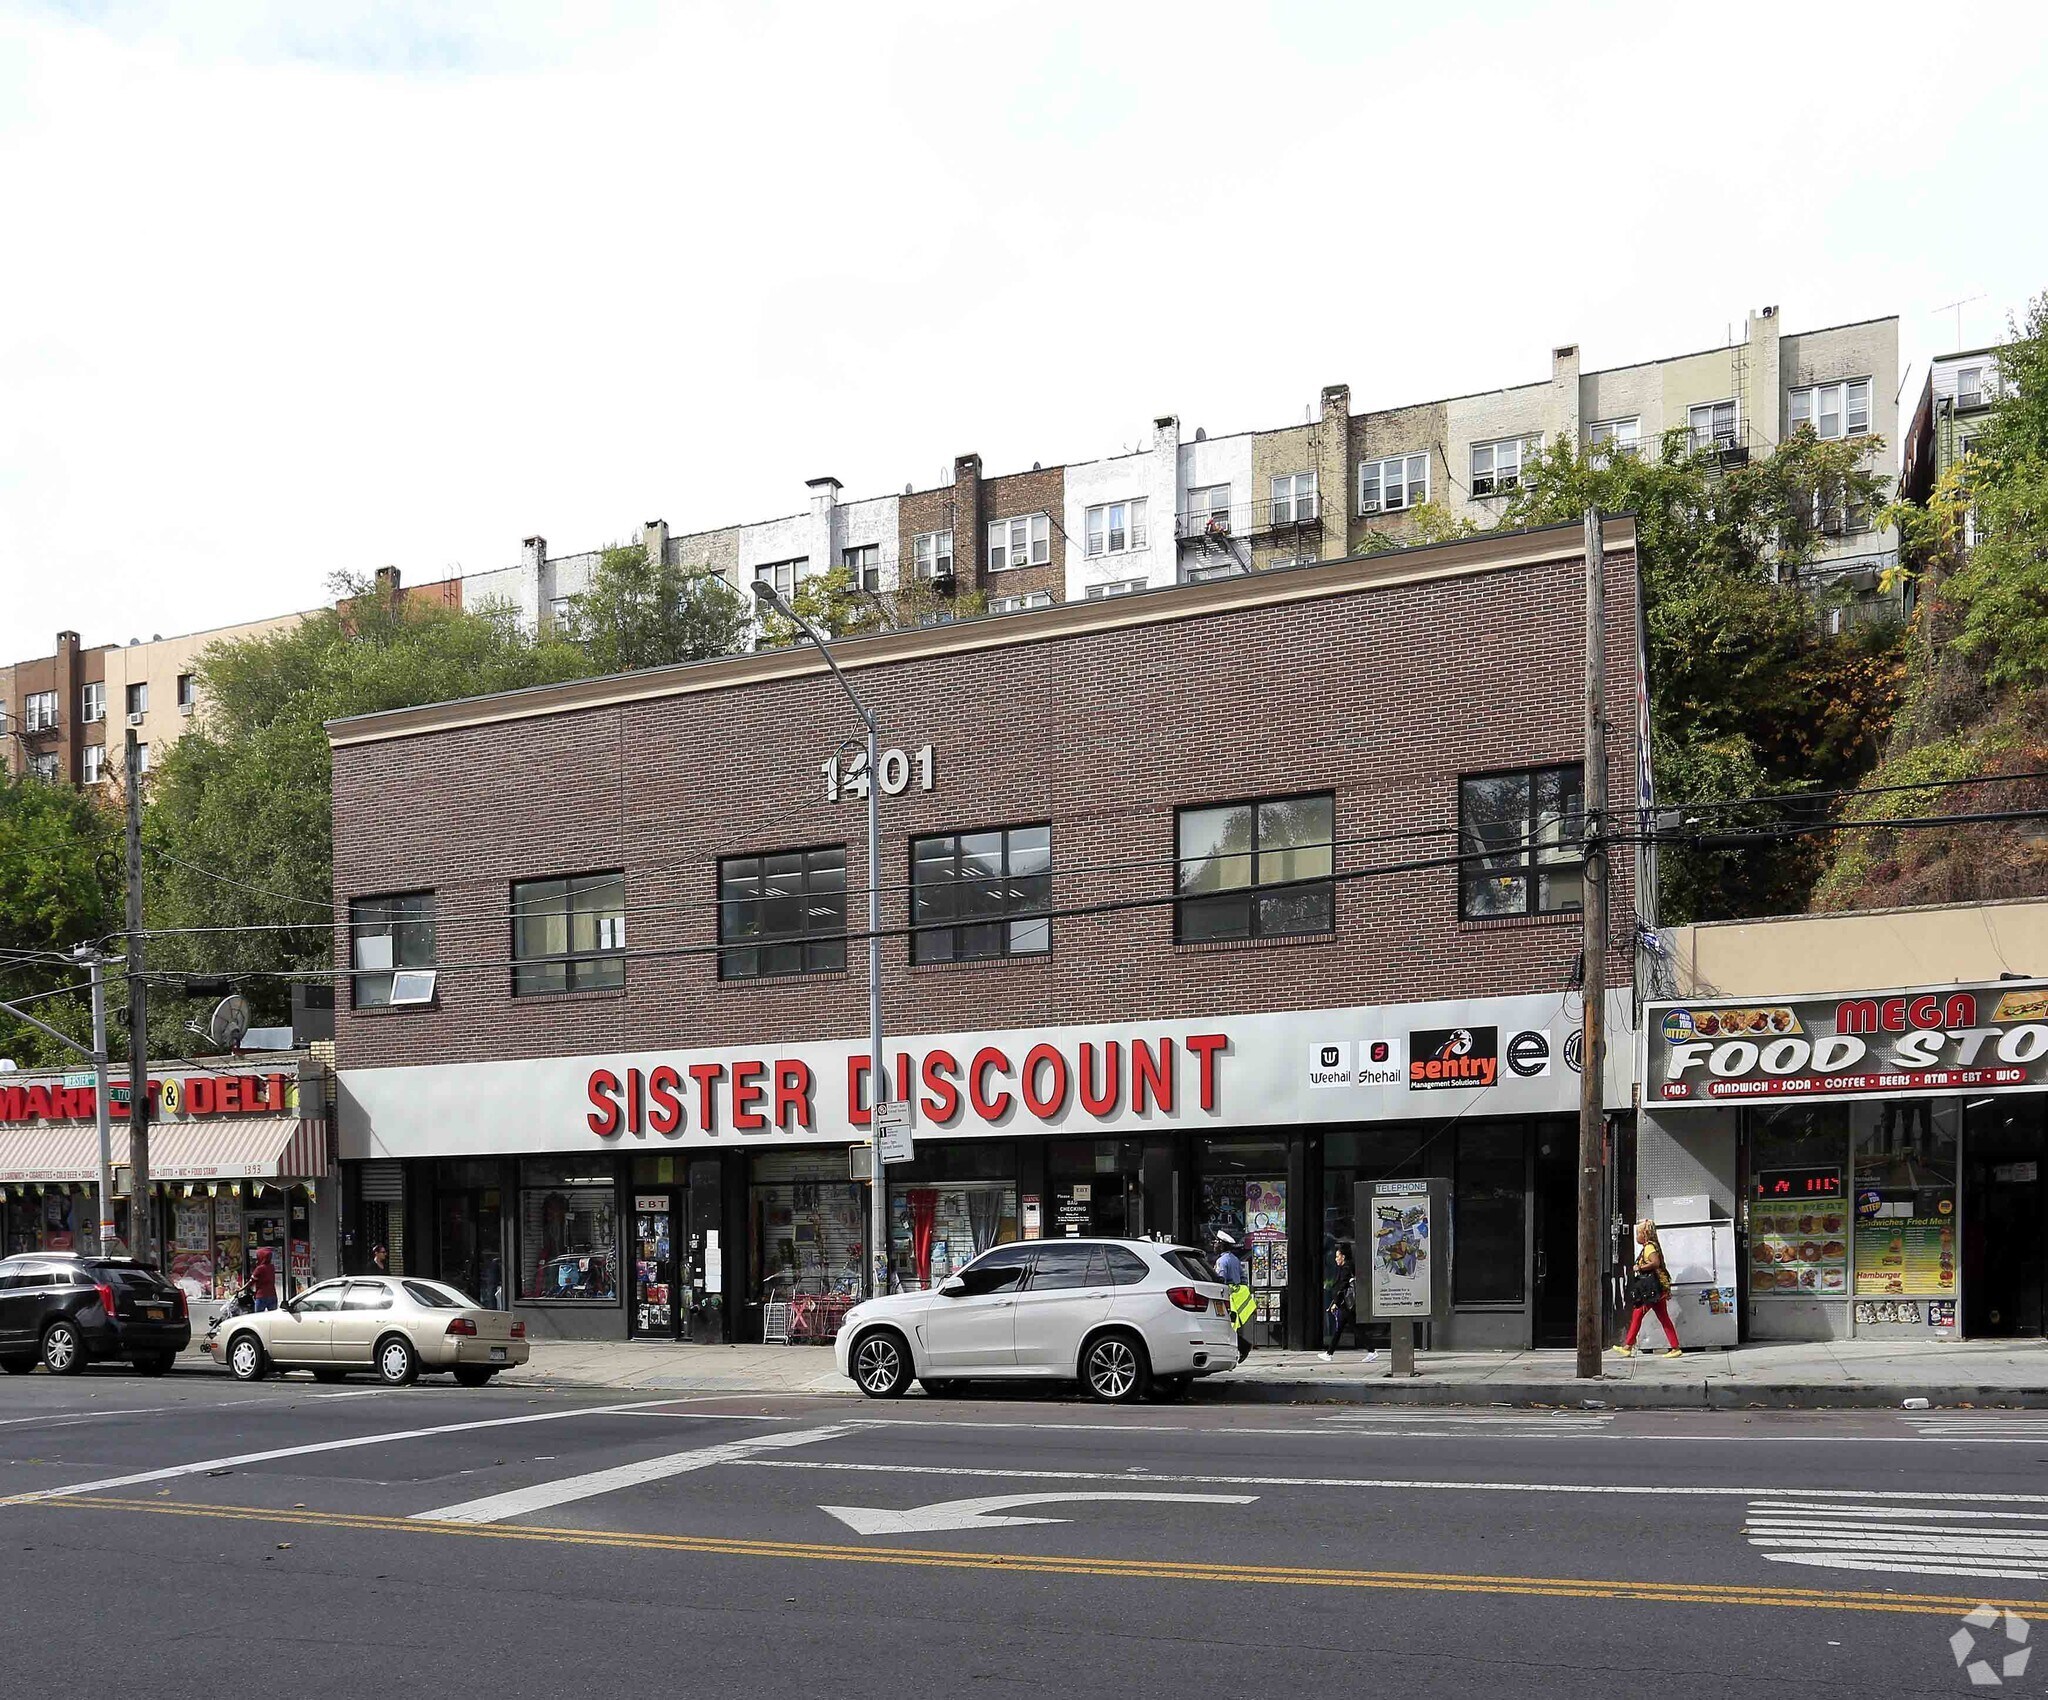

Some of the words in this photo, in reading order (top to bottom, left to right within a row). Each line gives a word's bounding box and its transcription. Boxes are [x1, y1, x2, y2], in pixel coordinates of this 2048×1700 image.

[822, 745, 934, 801] 1401
[1835, 993, 1978, 1034] MEGA
[1667, 1035, 1866, 1079] FOOD
[1889, 1023, 2048, 1073] STO
[1358, 1069, 1400, 1084] Shehail
[1410, 1056, 1496, 1085] sentry
[64, 1075, 90, 1087] WEBSTER
[1310, 1072, 1351, 1084] Weehail
[1411, 1081, 1450, 1089] Management
[1450, 1079, 1480, 1087] Solutions
[1712, 1082, 1768, 1094] SANDWICH
[1782, 1080, 1811, 1091] SODA
[1825, 1076, 1866, 1089] COFFEE
[1879, 1074, 1911, 1086] BEERS
[1924, 1073, 1948, 1084] ATM
[1962, 1071, 1982, 1082] EBT
[1996, 1069, 2020, 1081] WIC
[587, 1059, 809, 1136] SISTER
[847, 1034, 1227, 1124] DISCOUNT
[1663, 1084, 1687, 1095] 1405
[118, 1089, 130, 1101] 170
[184, 1073, 286, 1114] DELI
[244, 1165, 261, 1175] 1393
[1376, 1183, 1426, 1192] TELEPHONE
[1907, 1218, 1929, 1226] Fried
[1856, 1271, 1902, 1279] Hamburger
